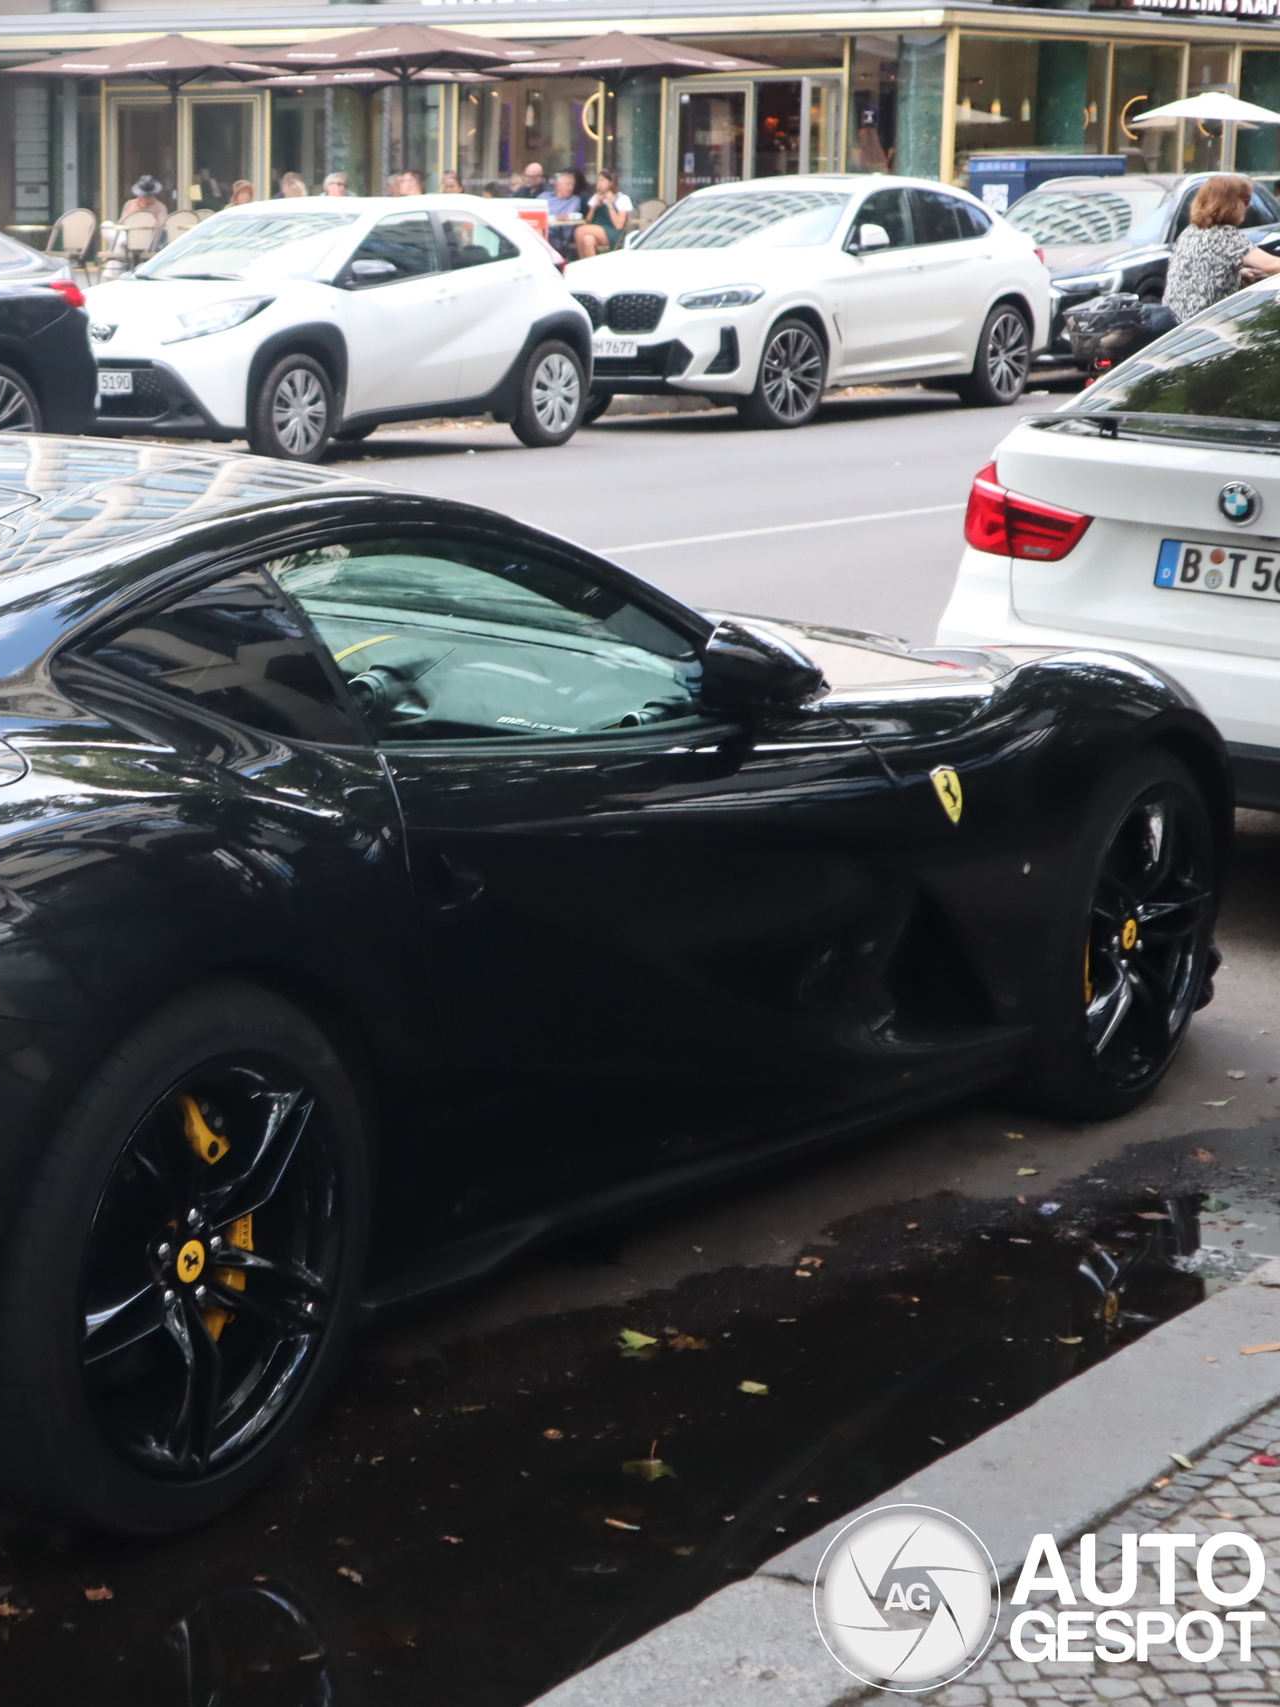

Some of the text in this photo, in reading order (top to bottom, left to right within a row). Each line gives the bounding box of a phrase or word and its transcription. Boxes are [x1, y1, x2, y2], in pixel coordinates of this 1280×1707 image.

[1241, 0, 1280, 15] KAF
[606, 341, 634, 354] 7677
[102, 375, 131, 390] 5190
[1180, 548, 1202, 583] B
[1228, 553, 1247, 588] T
